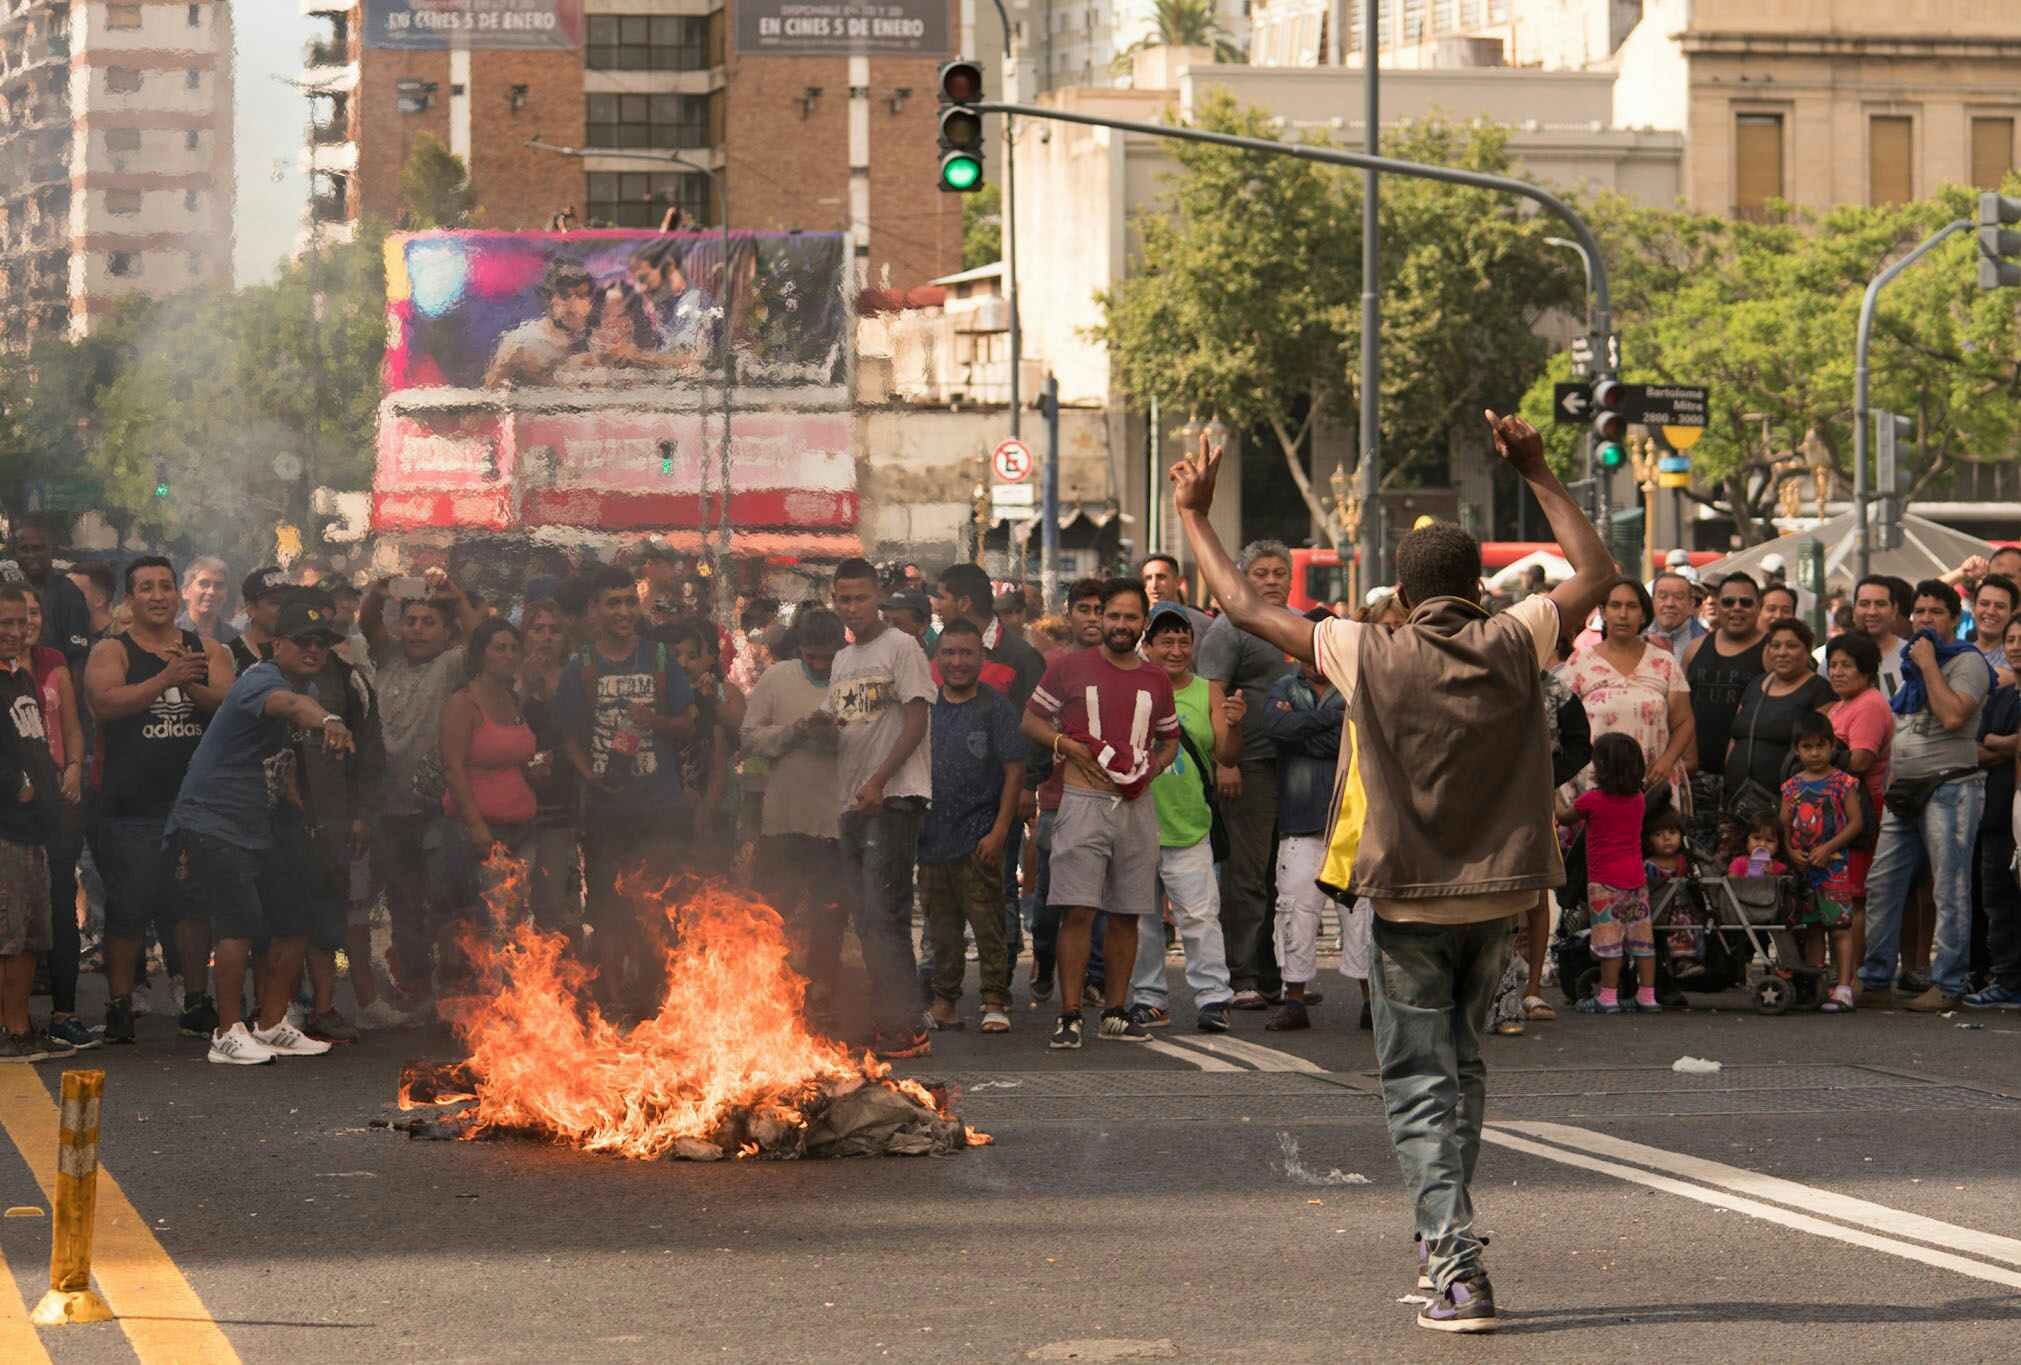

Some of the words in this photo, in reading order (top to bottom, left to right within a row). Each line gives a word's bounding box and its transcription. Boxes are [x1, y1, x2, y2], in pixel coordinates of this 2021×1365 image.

[478, 12, 499, 29] DE
[759, 17, 781, 35] EN
[784, 18, 830, 36] CINES
[848, 18, 869, 36] DE
[873, 18, 925, 37] ENERO
[1006, 451, 1020, 472] E
[142, 719, 202, 739] adidas
